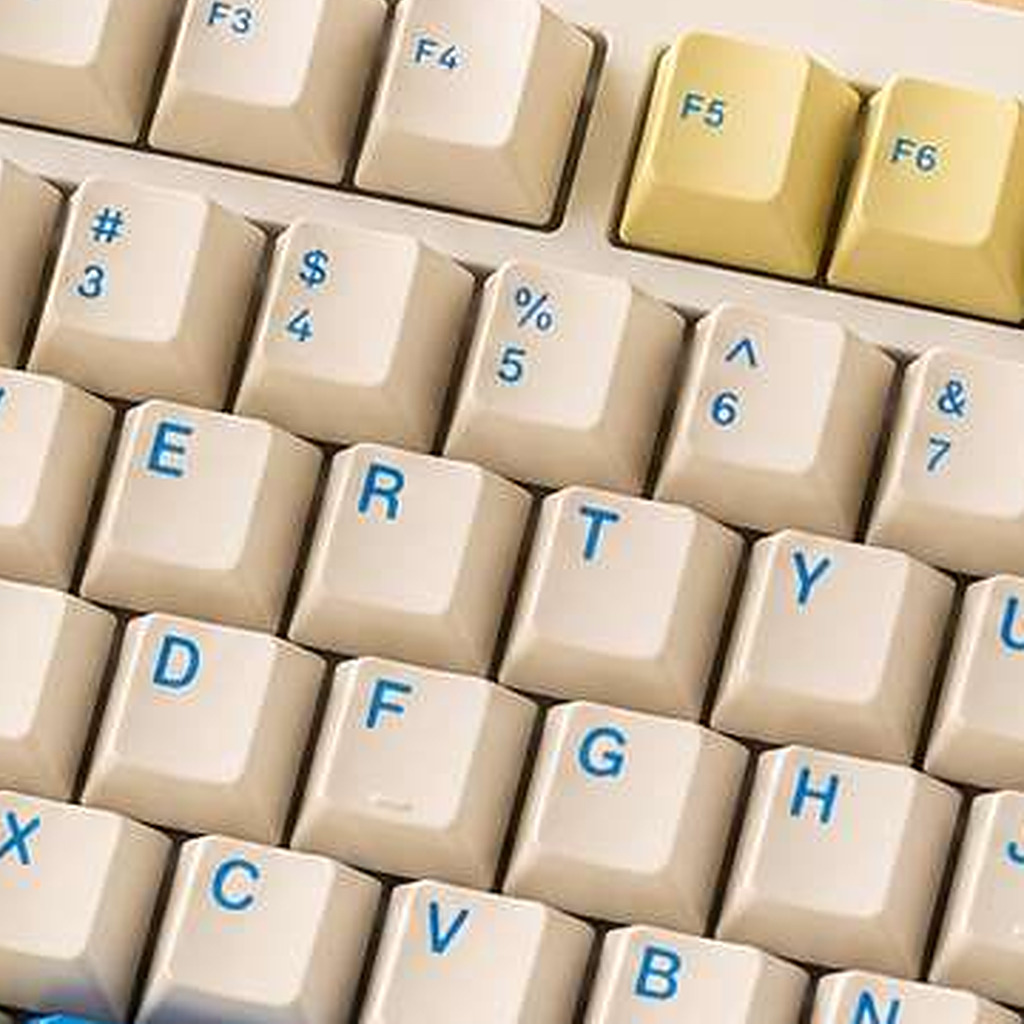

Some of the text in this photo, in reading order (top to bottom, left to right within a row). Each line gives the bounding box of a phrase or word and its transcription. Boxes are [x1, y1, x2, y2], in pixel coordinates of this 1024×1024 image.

[207, 1, 252, 34] F3
[414, 38, 457, 70] F4
[680, 93, 725, 128] F5
[890, 137, 937, 172] F6
[91, 207, 124, 244] #
[77, 265, 105, 299] 3
[298, 249, 329, 288] $
[286, 309, 313, 343] 4
[514, 287, 552, 331] %
[497, 347, 526, 383] 5
[711, 392, 738, 426] 6
[937, 380, 966, 417] &
[147, 421, 193, 478] E
[927, 437, 951, 472] 7
[358, 463, 405, 520] R
[579, 506, 620, 561] T
[793, 551, 830, 605] Y
[152, 635, 200, 689] D
[366, 679, 412, 729] F
[578, 727, 626, 777] G
[790, 767, 839, 824] H
[212, 859, 260, 911] C
[429, 901, 469, 954] V
[635, 946, 681, 1000] B
